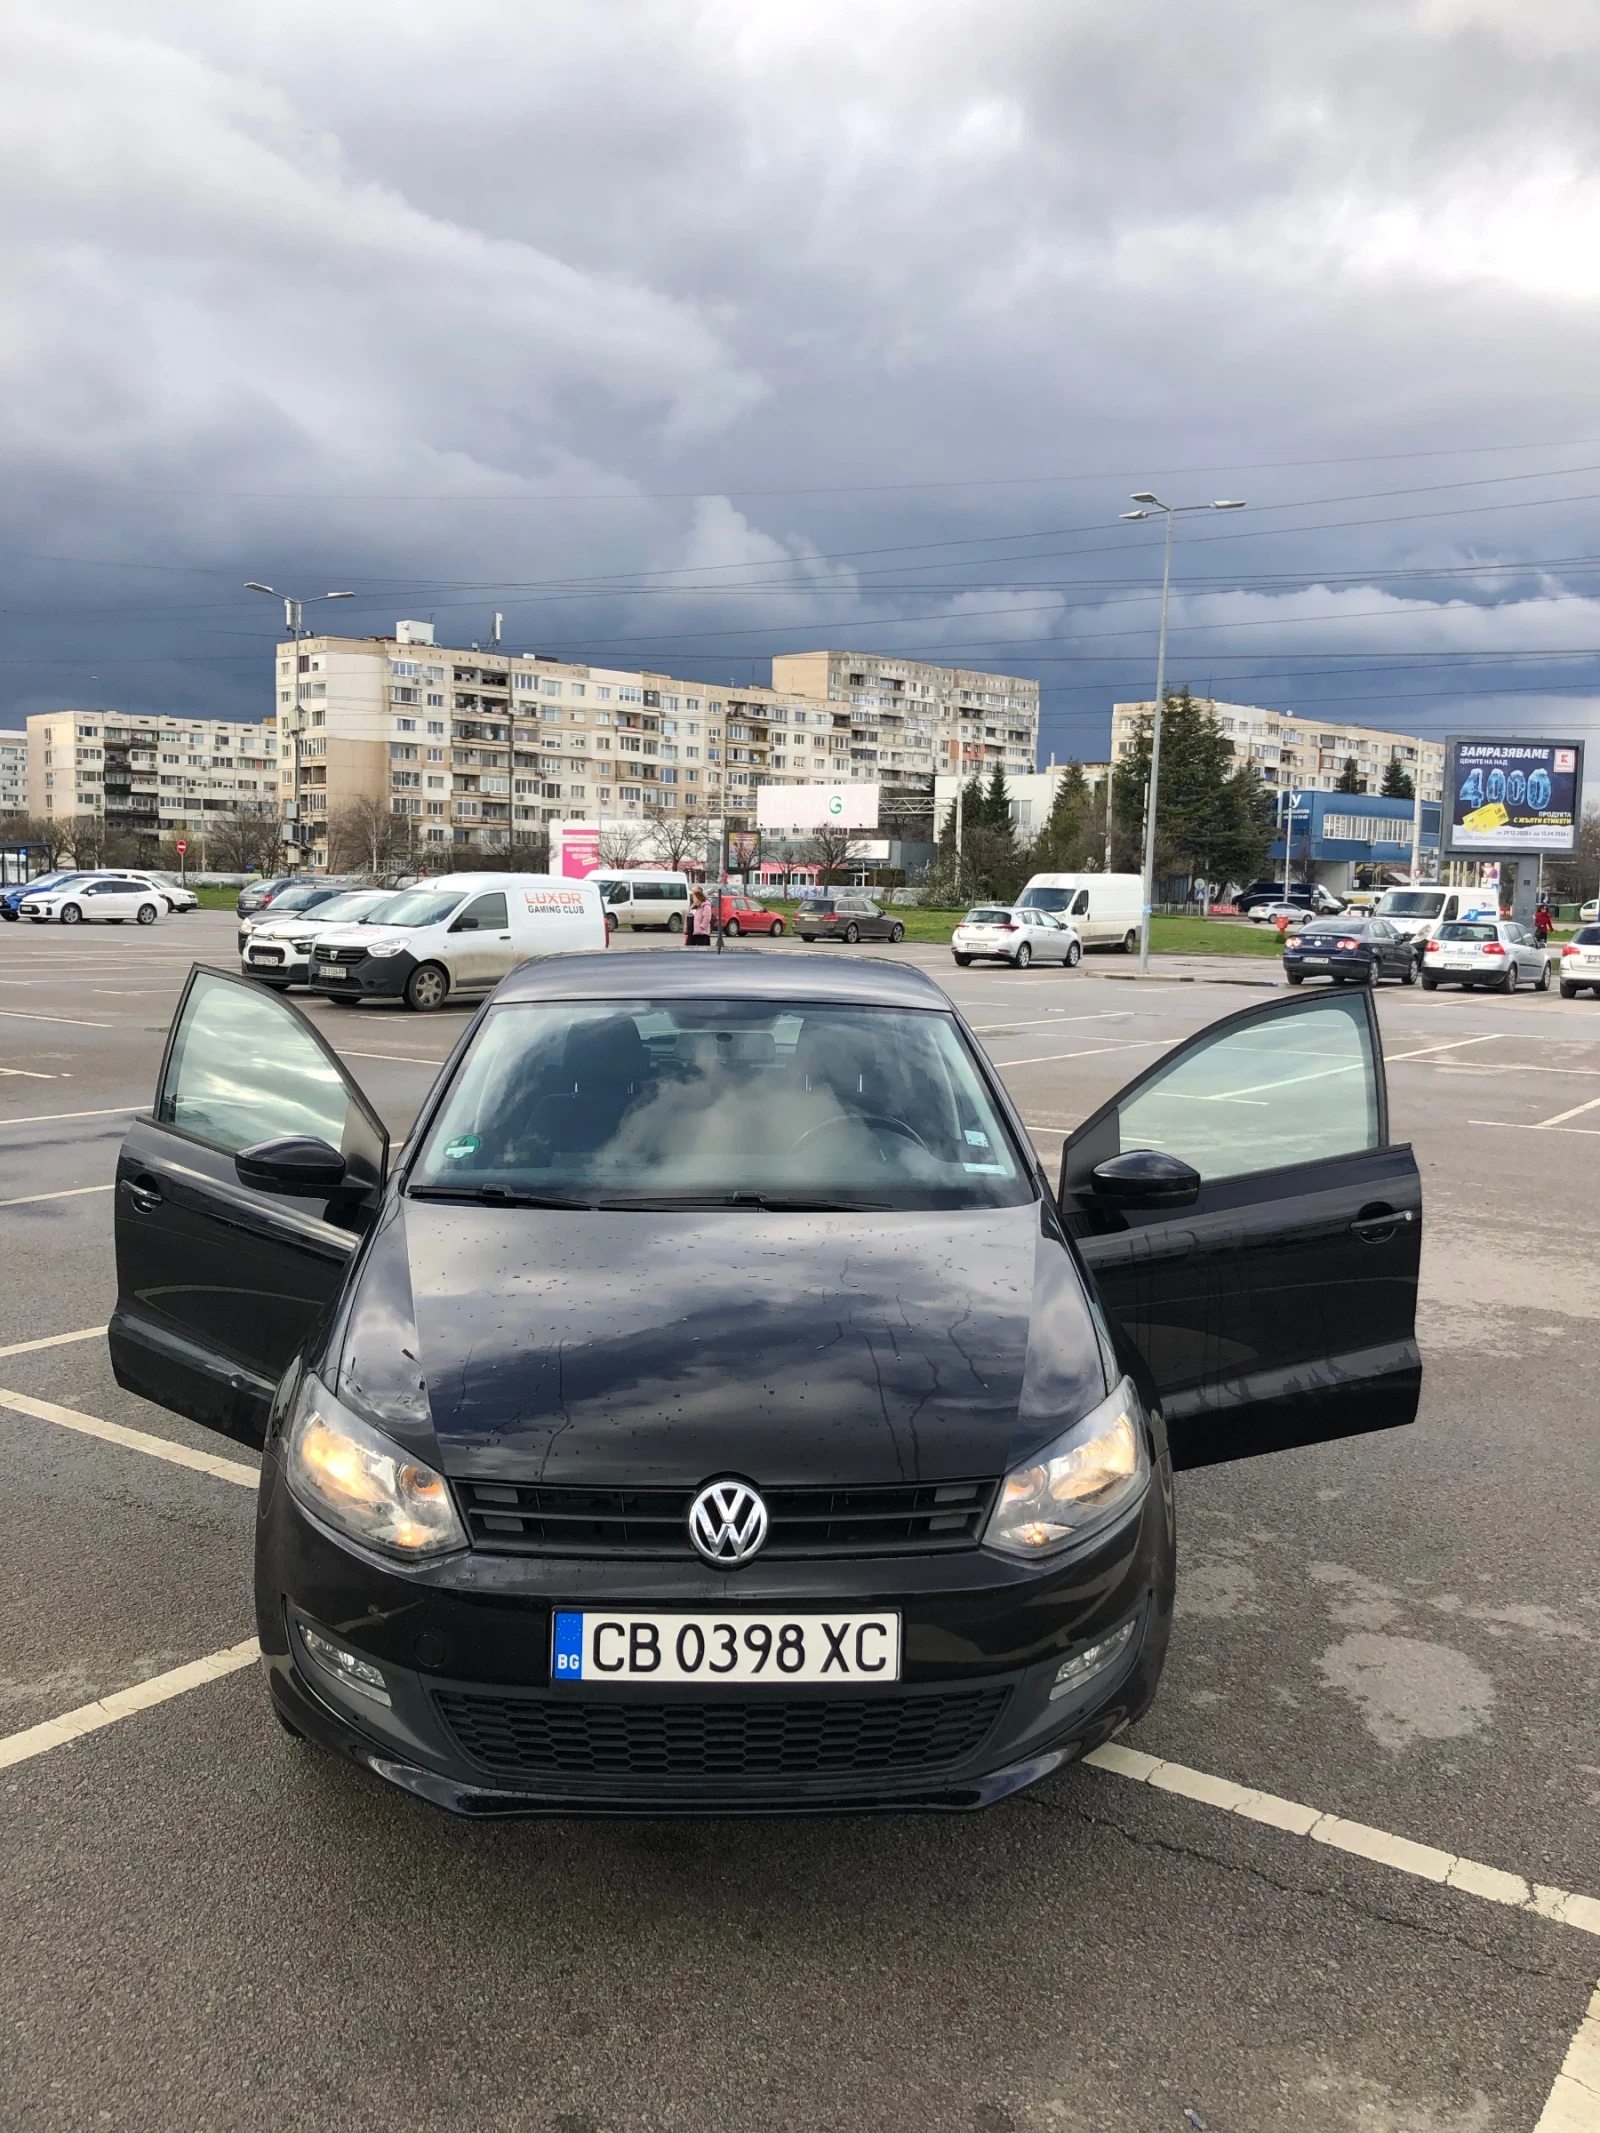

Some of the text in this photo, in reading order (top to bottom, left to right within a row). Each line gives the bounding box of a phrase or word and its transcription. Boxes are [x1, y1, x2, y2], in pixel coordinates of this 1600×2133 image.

[1460, 746, 1550, 759] ЗАМРАЗЯВАМЕ
[1459, 768, 1551, 810] 4000
[524, 892, 583, 904] LUXOR
[528, 905, 585, 914] GAMING CLUB
[592, 1622, 888, 1673] CB 0398 XC
[557, 1653, 580, 1670] BG
